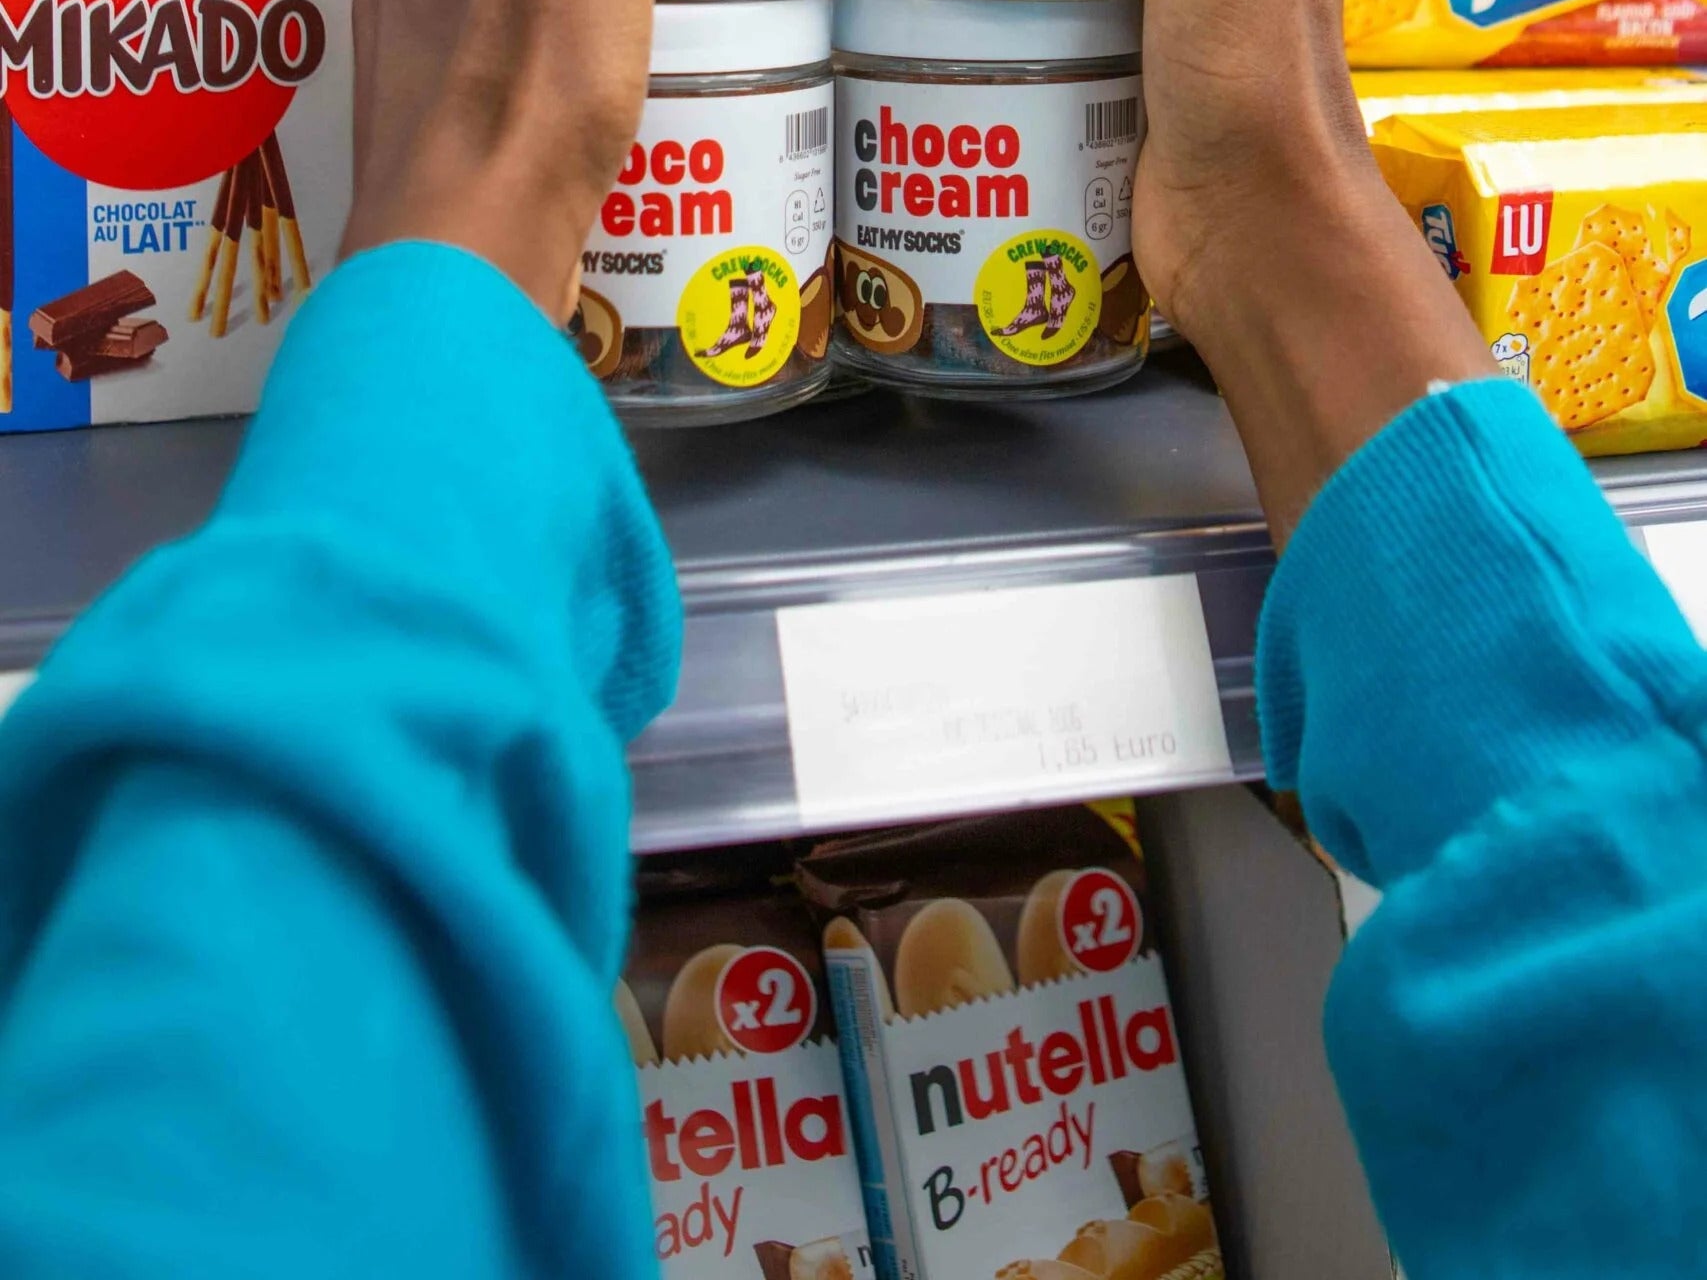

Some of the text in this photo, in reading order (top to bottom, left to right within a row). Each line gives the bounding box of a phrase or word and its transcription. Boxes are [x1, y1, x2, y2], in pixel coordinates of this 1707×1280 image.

[854, 105, 1020, 168] choco
[617, 138, 724, 186] oco
[93, 200, 197, 224] CHOCOLAT
[601, 189, 733, 237] eam
[854, 168, 1029, 218] cream
[93, 225, 118, 243] AU
[857, 224, 962, 254] EAT MY SOCKS
[1502, 203, 1544, 257] LU
[601, 252, 664, 275] SOCKS
[712, 255, 788, 289] CREW SOCKS
[1007, 238, 1089, 274] CREW SOCKS
[1001, 337, 1018, 355] One
[1019, 349, 1039, 361] size
[1039, 350, 1056, 362] fits
[1055, 338, 1077, 355] most
[1495, 344, 1508, 354] 7 x
[1072, 887, 1132, 954] x2
[731, 967, 803, 1031] x2
[909, 994, 1177, 1136] nutella
[644, 1076, 848, 1182] tella
[923, 1100, 1095, 1232] B-ready
